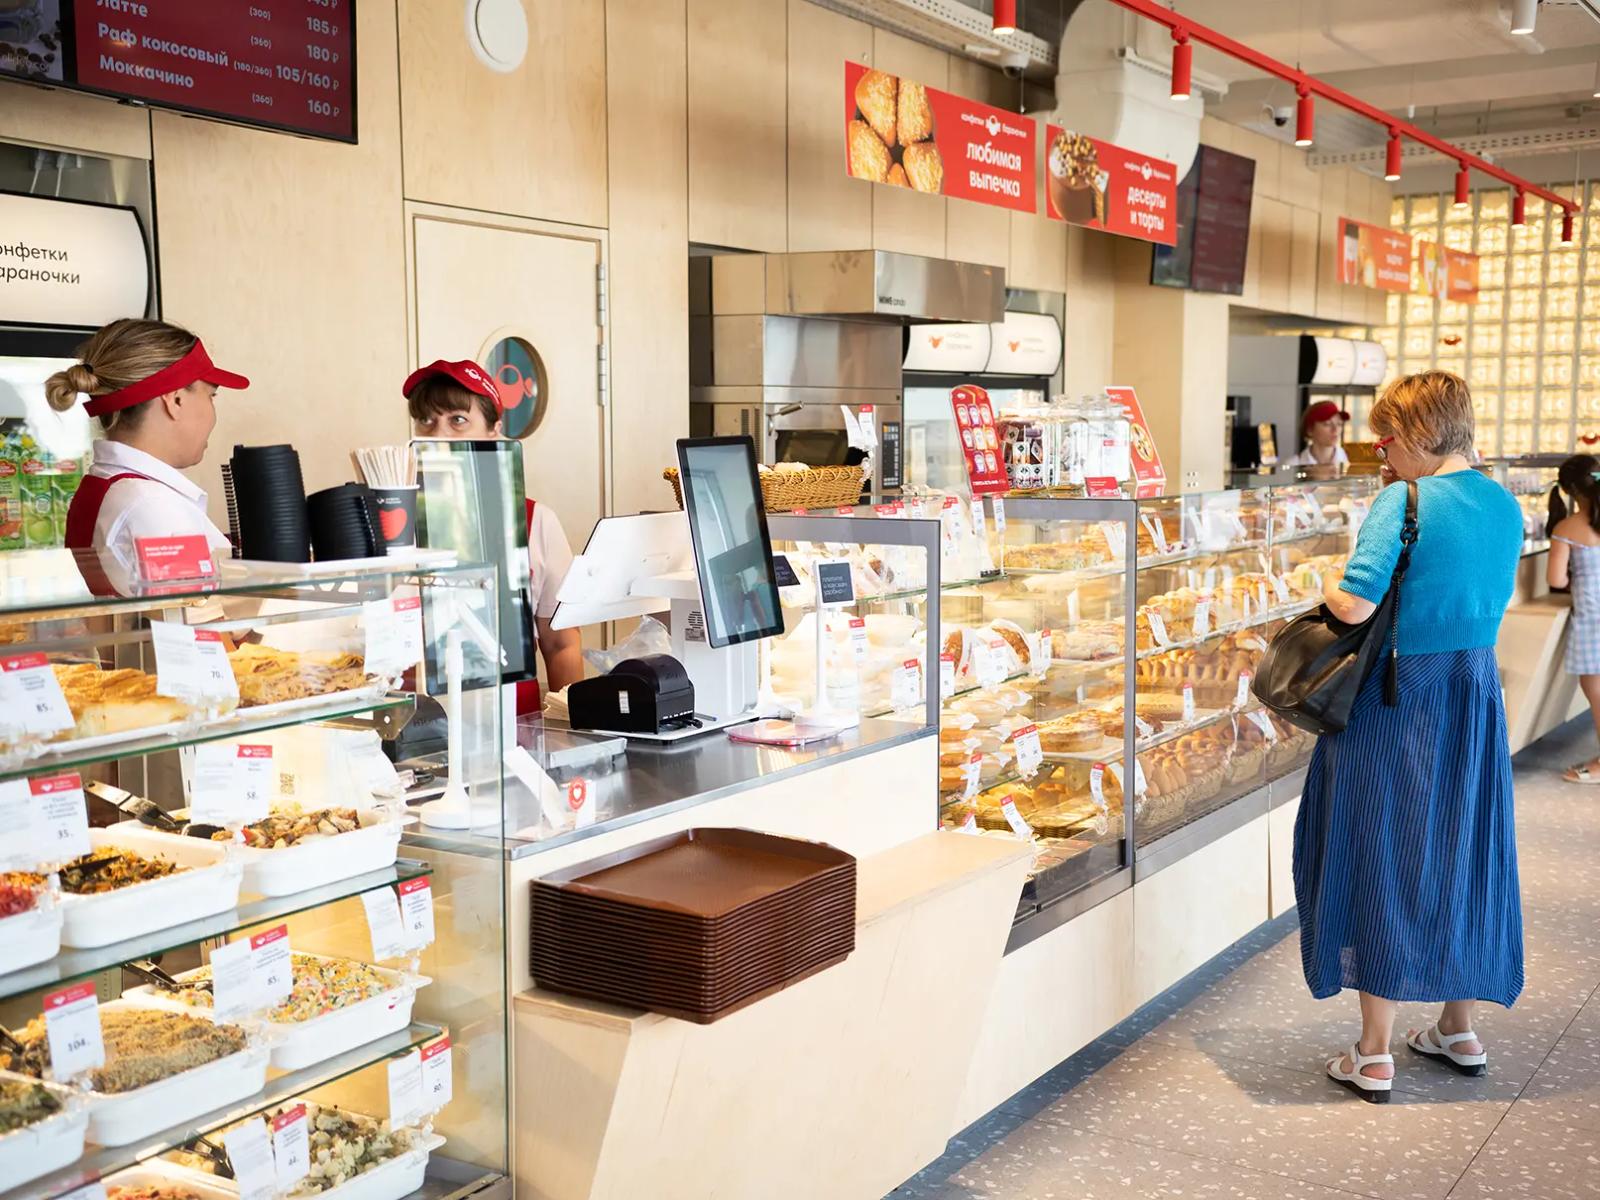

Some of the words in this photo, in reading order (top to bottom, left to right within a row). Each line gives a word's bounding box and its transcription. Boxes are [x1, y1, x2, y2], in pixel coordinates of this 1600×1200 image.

[306, 16, 330, 34] 185
[98, 22, 137, 48] Раф
[142, 35, 229, 67] кокосовый
[276, 65, 331, 89] 105/160
[306, 44, 330, 62] 180
[99, 54, 194, 88] Моккачино
[307, 99, 331, 116] 160
[966, 141, 1022, 172] любимая
[969, 170, 1021, 198] выпечка
[1127, 186, 1167, 212] десерты
[1130, 210, 1137, 225] и
[1138, 212, 1165, 235] торты
